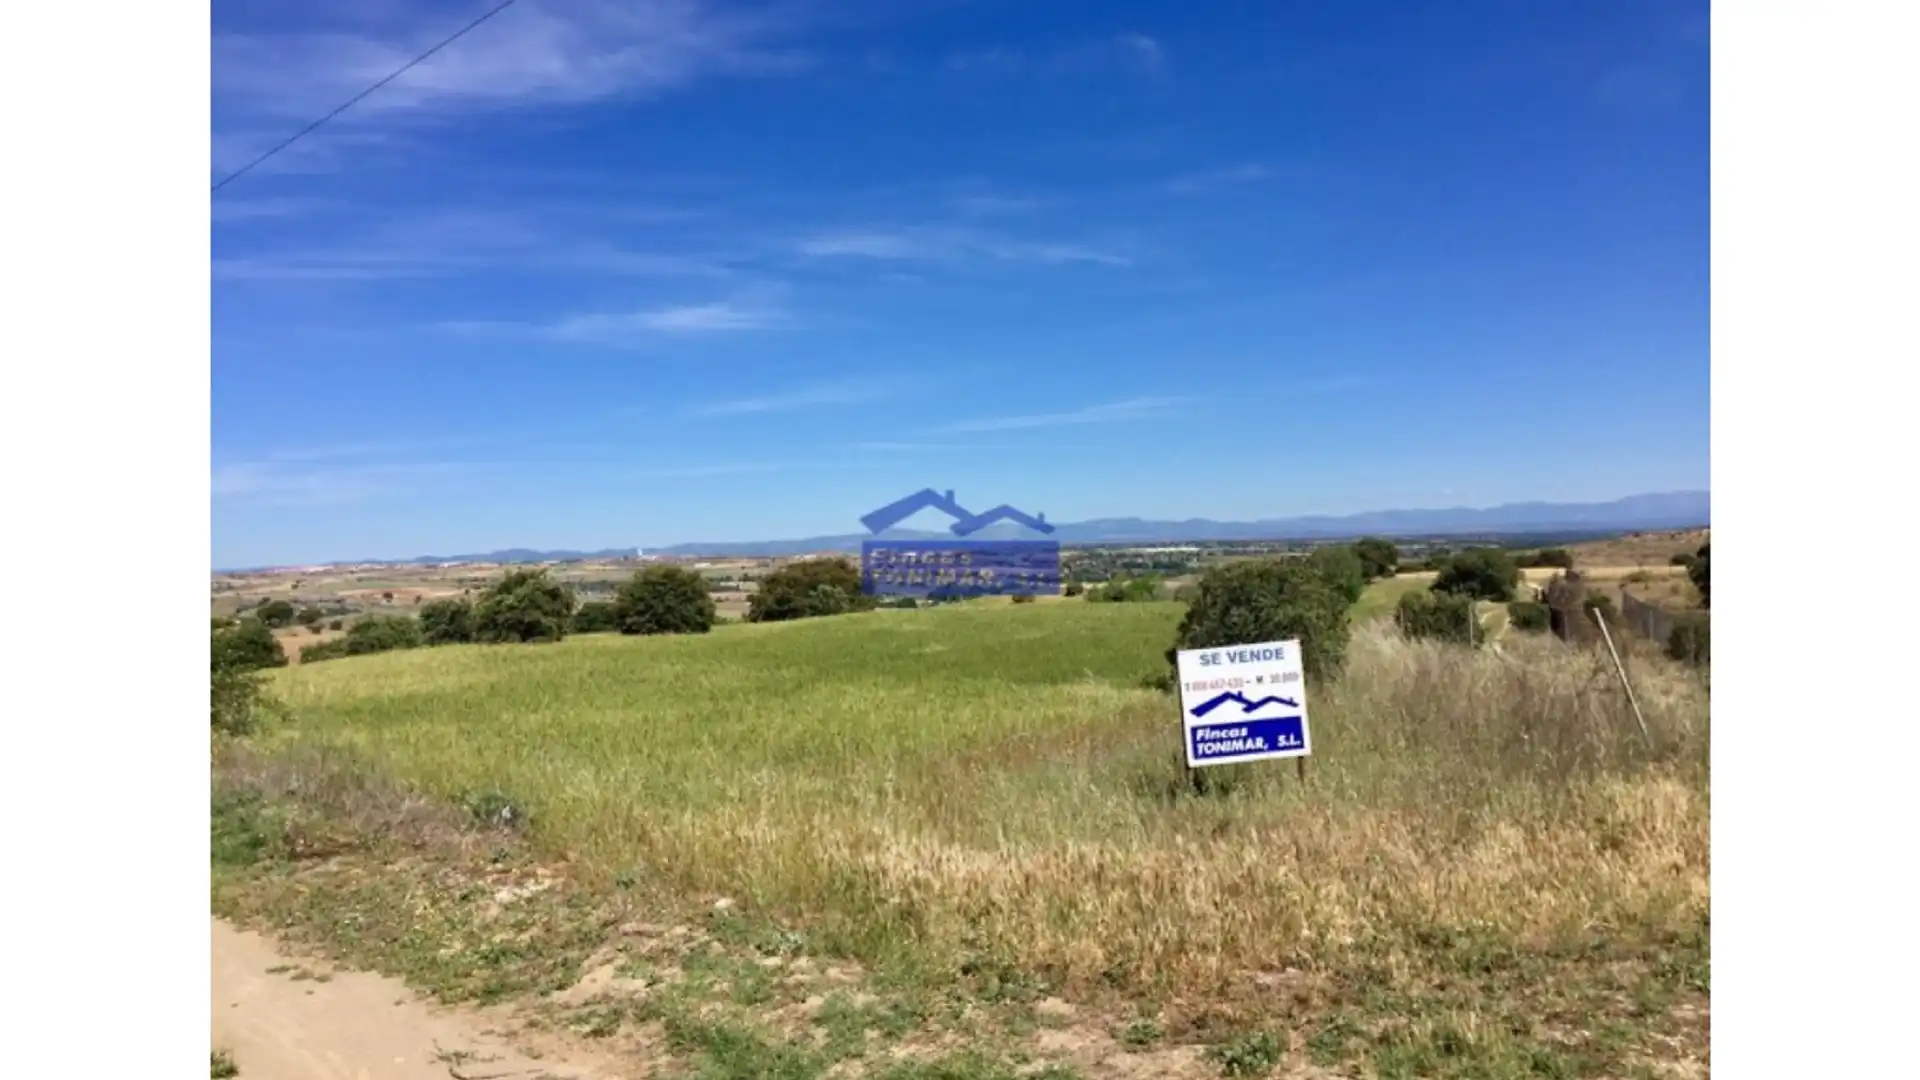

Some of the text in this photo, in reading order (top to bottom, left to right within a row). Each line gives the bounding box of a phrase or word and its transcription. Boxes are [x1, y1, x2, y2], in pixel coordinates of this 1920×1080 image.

[1199, 647, 1285, 667] SE VENDE
[1195, 727, 1249, 742] Fincas
[1196, 733, 1301, 756] TONIMAR, S.L.
